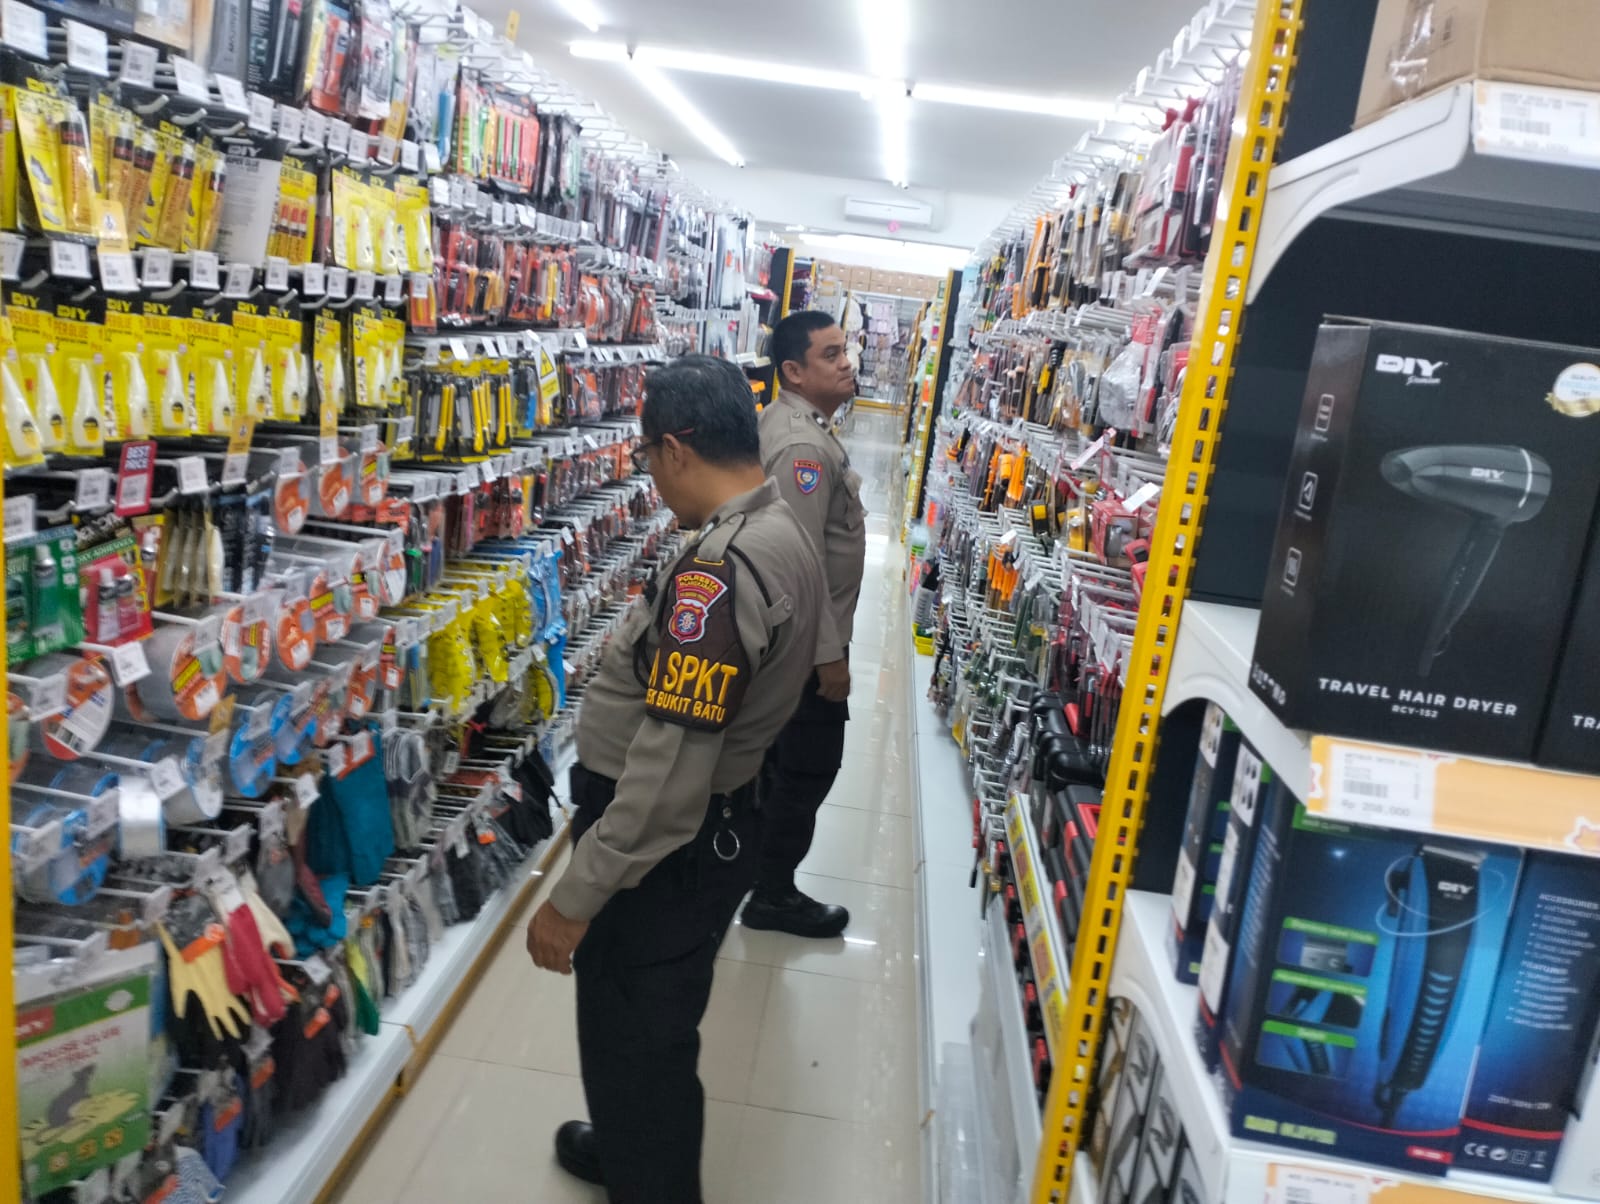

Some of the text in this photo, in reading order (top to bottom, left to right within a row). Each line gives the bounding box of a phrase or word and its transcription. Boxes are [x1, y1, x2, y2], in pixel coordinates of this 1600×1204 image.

[227, 145, 261, 158] DIY
[11, 291, 40, 309] DIY
[106, 297, 132, 313] DIY
[143, 301, 171, 315] DIY
[56, 304, 90, 321] DIY
[1375, 354, 1444, 377] DIY
[127, 445, 151, 459] BEST
[125, 457, 149, 471] PRICE
[1471, 467, 1505, 480] DIY
[662, 651, 738, 705] SPKT
[1319, 678, 1518, 716] TRAVEL HAIR DRYER
[656, 691, 692, 714] BUKIT
[692, 700, 726, 723] BATU
[1437, 881, 1474, 895] DIY
